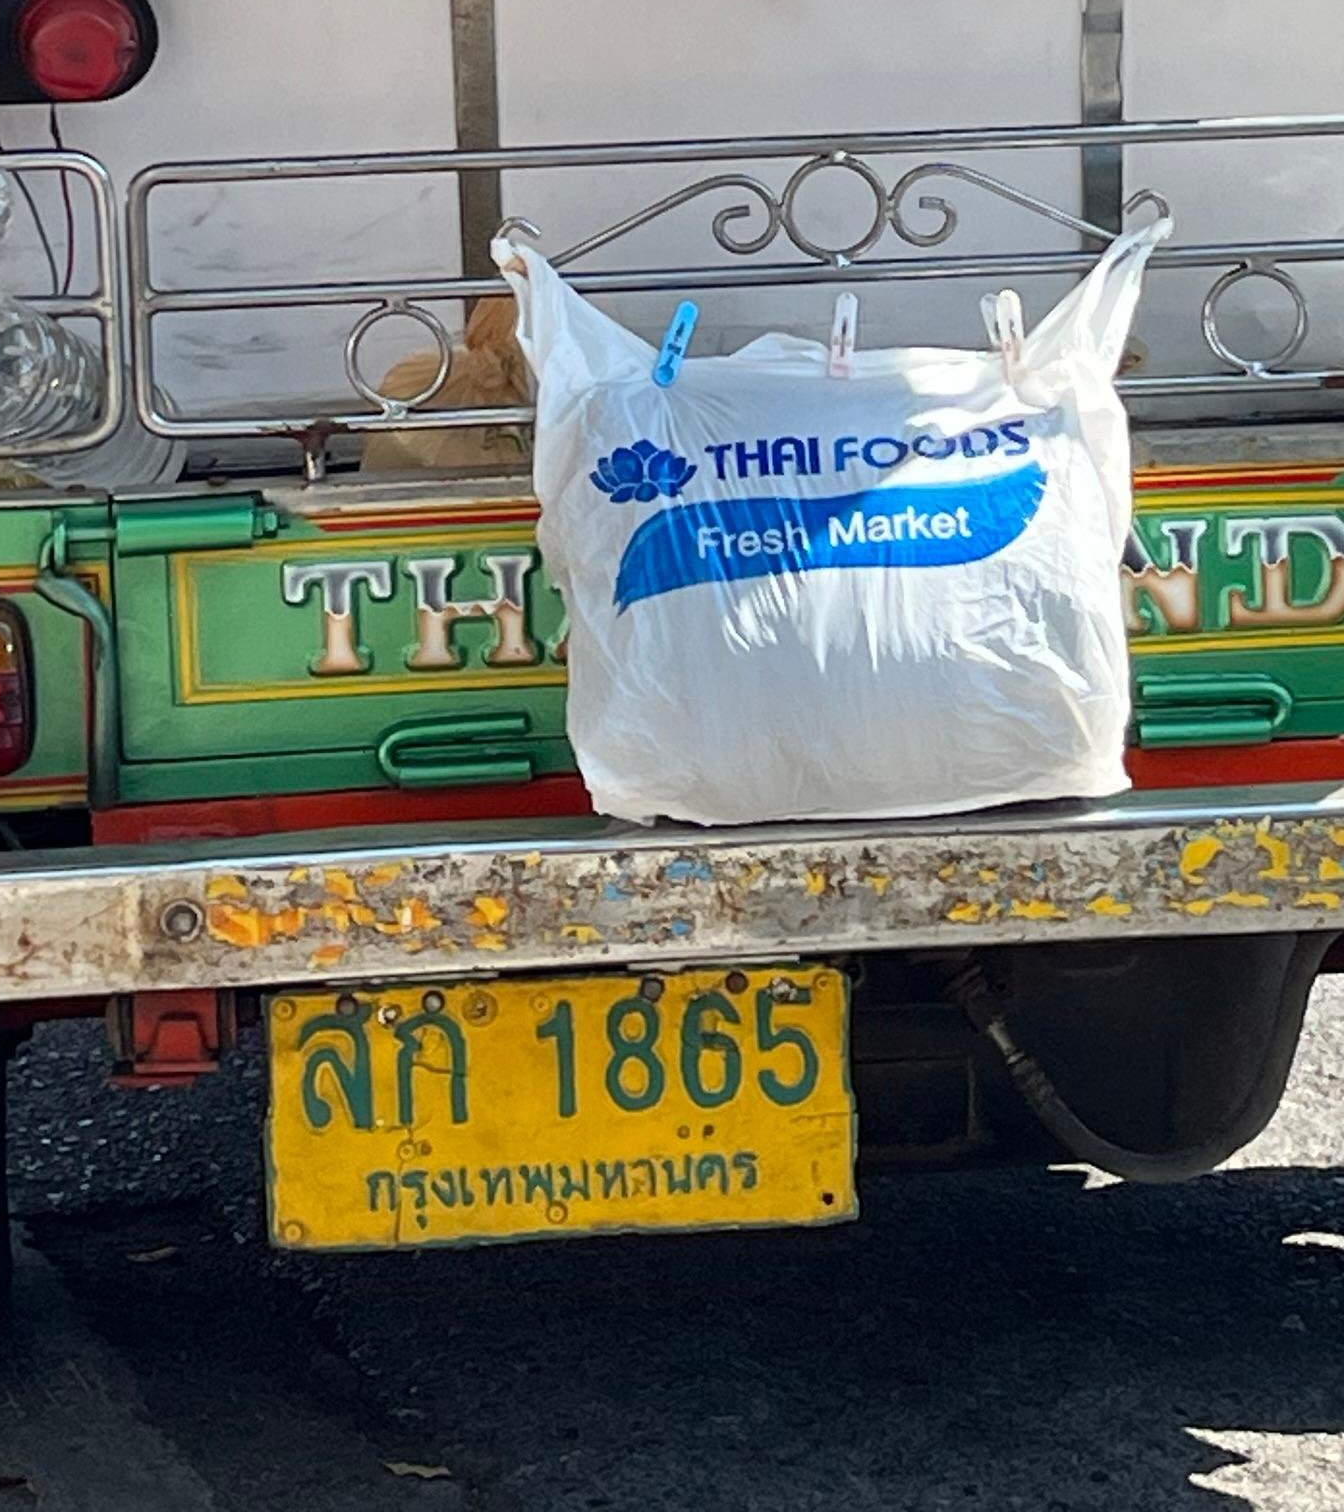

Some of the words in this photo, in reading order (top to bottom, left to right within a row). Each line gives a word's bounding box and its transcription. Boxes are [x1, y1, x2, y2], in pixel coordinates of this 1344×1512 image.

[704, 437, 821, 479] THAI
[834, 420, 1032, 473] FOODS
[696, 520, 810, 560] Fresh
[828, 505, 972, 548] Market
[537, 982, 820, 1120] 1865
[365, 1150, 759, 1232] กรุงเทพมหานคร
